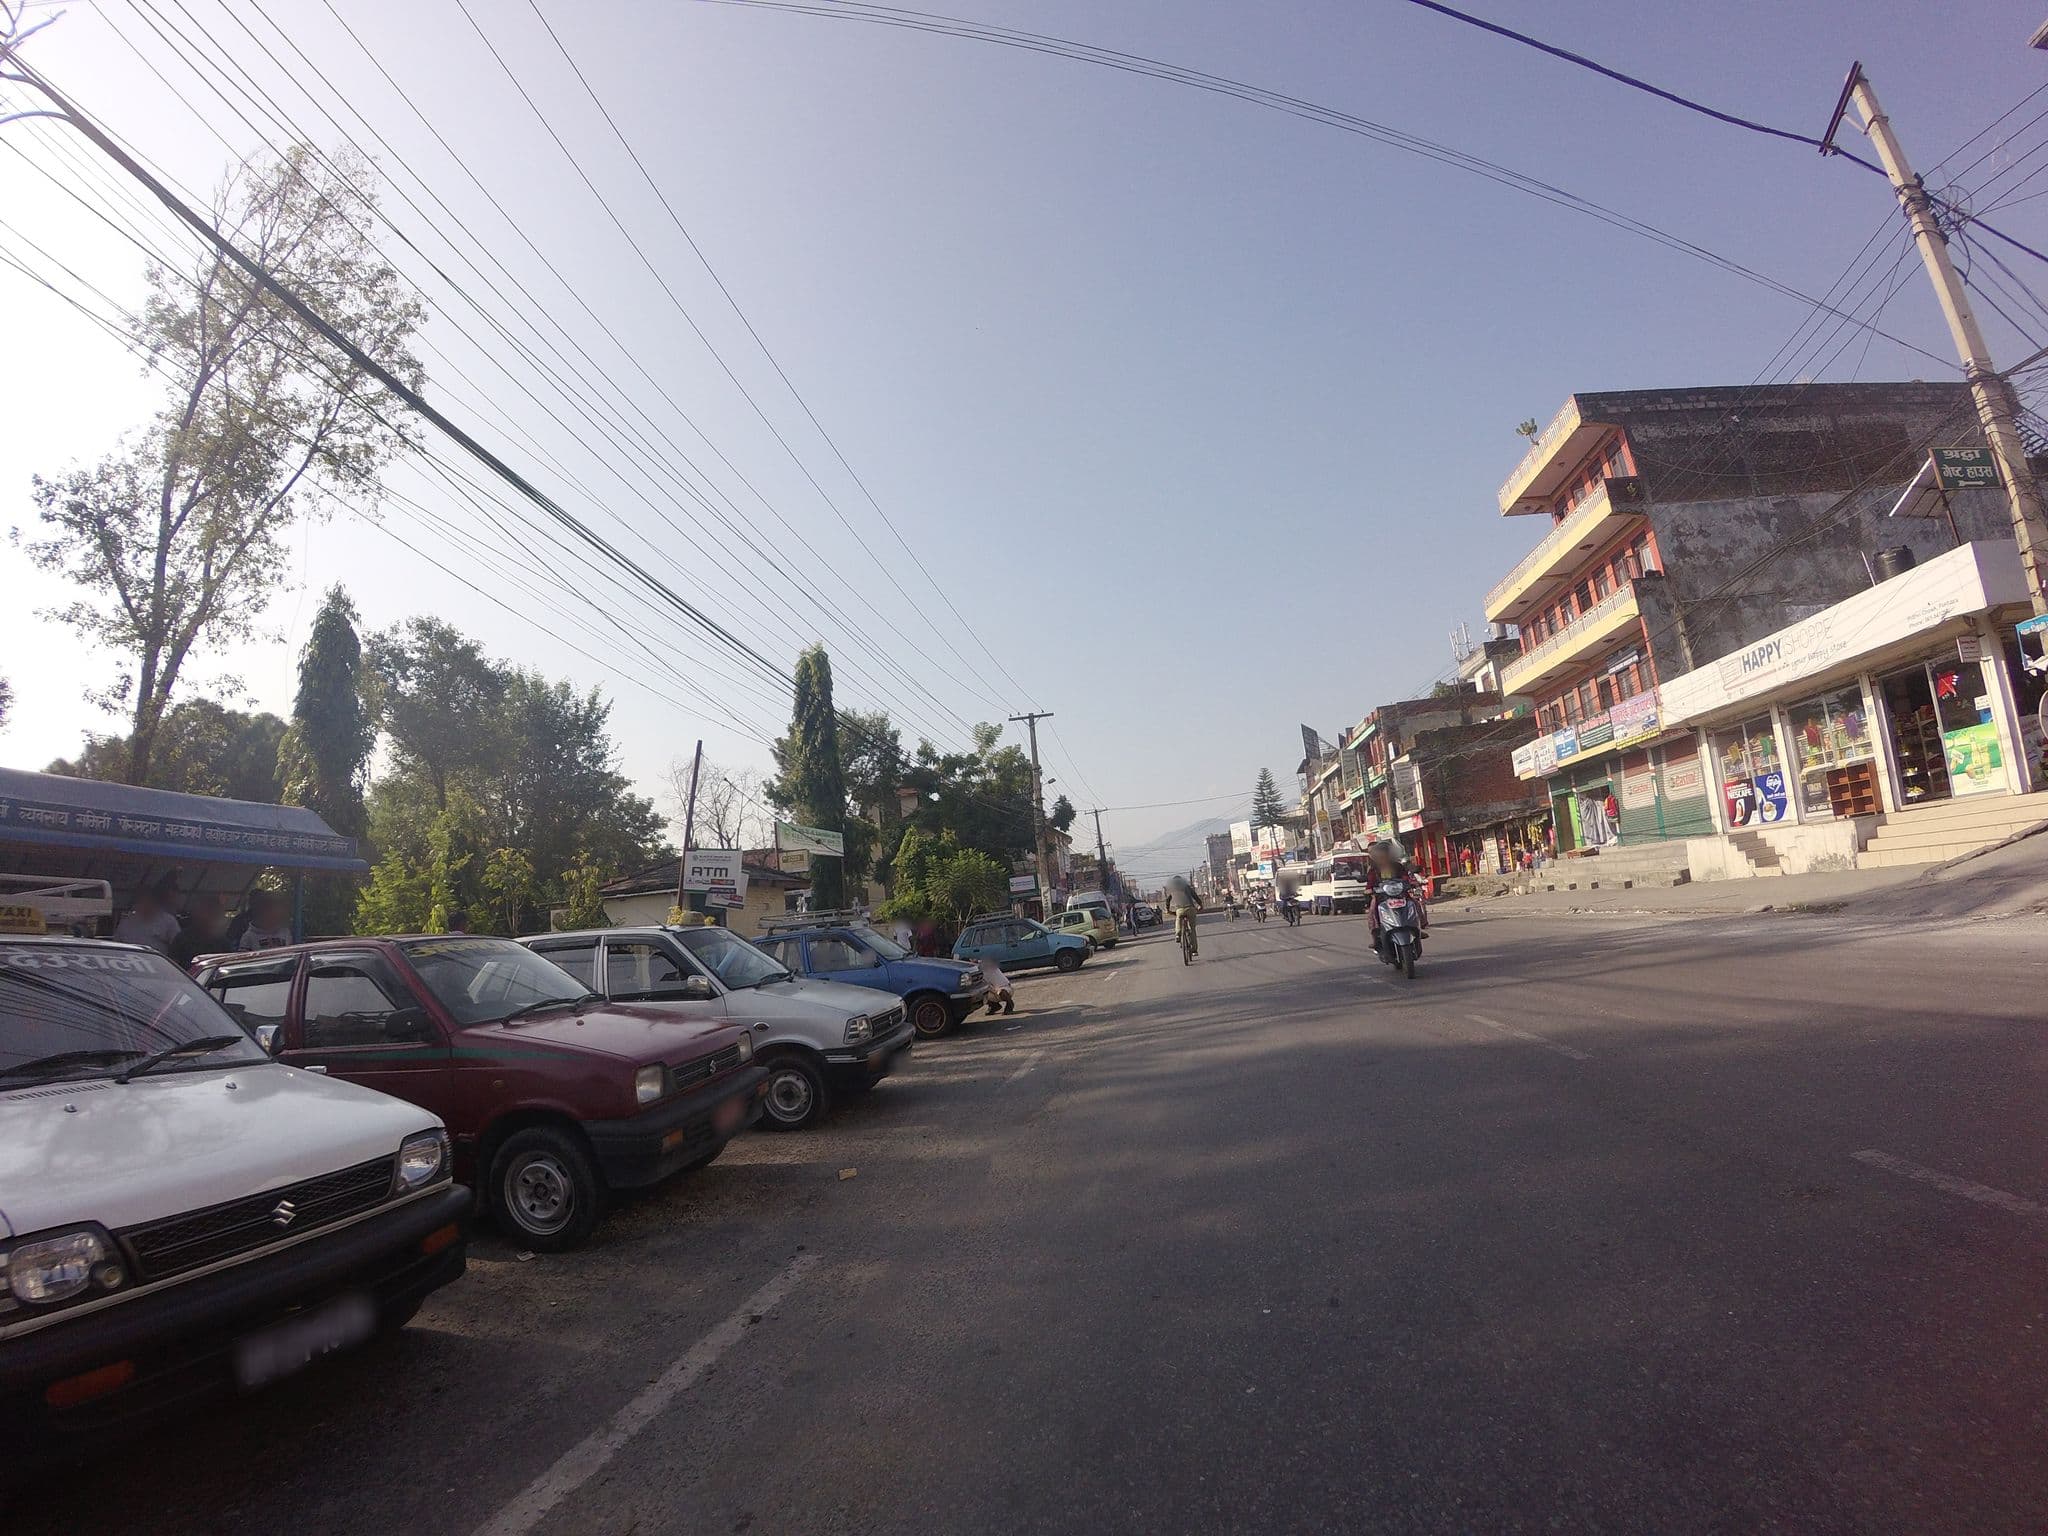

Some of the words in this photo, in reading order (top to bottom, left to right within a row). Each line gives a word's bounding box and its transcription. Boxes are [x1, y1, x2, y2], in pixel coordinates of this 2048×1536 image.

[1742, 638, 1783, 673] HAPPY
[1784, 617, 1832, 656] SHOPPE
[691, 866, 729, 878] ATM
